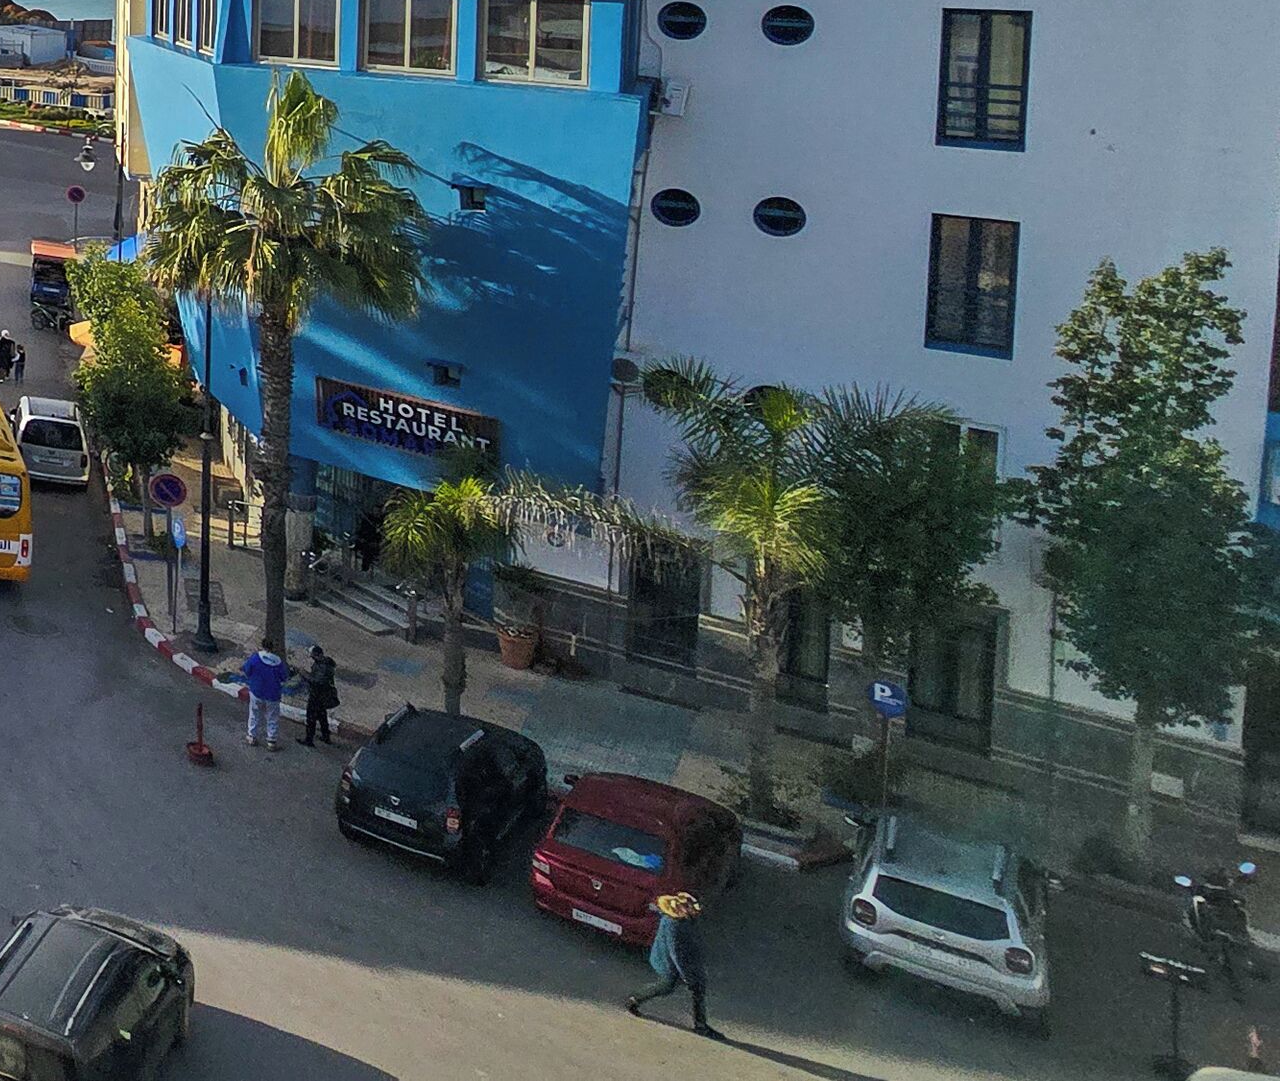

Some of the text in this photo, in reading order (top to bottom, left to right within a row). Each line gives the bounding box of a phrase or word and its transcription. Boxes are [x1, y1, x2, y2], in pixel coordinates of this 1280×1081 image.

[342, 402, 491, 453] RESTAURANT
[379, 397, 464, 433] HOTEL
[874, 682, 892, 701] P
